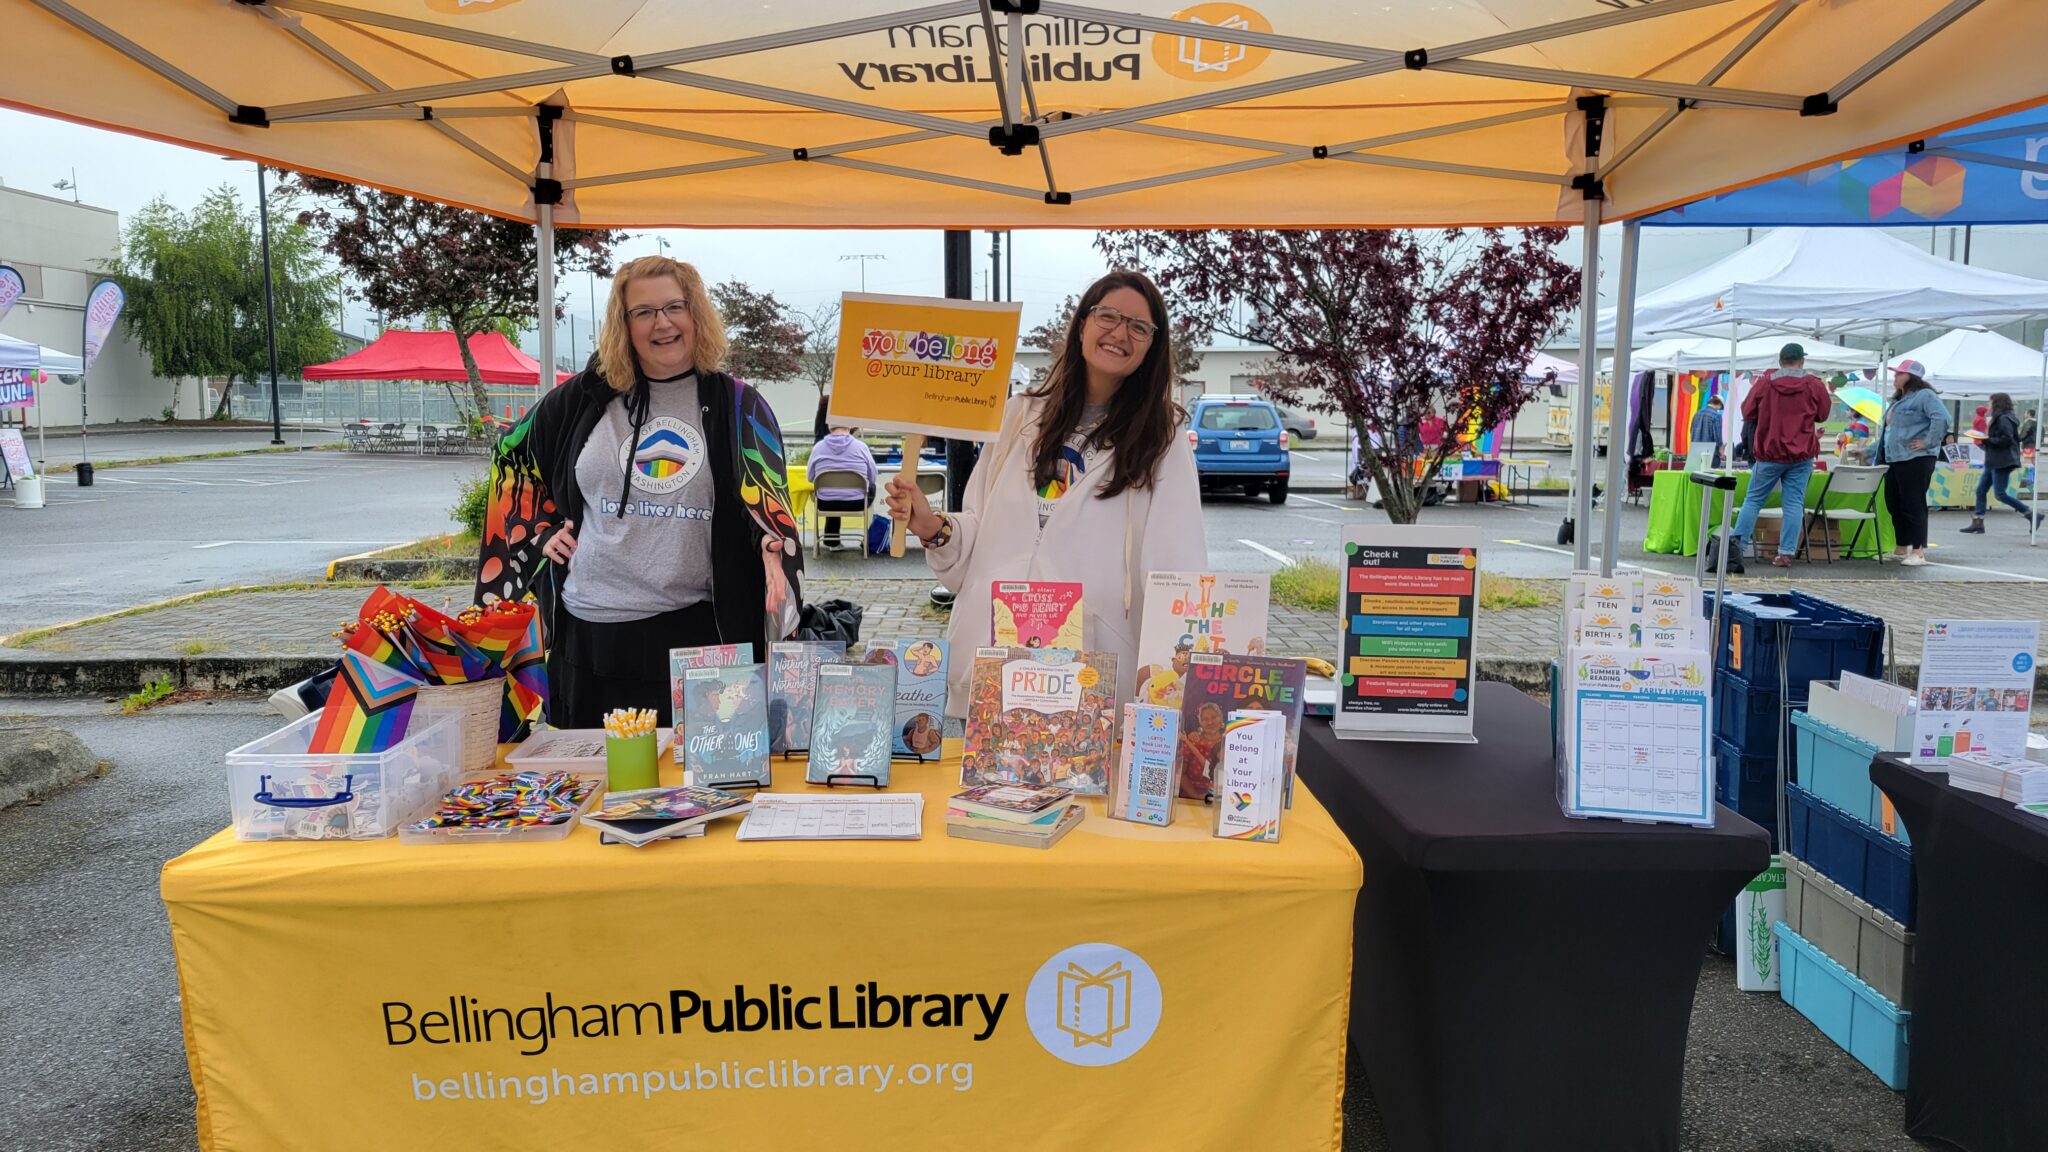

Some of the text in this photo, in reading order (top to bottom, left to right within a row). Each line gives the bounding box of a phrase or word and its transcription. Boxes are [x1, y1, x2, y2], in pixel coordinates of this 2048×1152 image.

[865, 333, 996, 367] you belong
[923, 364, 983, 387] library
[656, 419, 701, 455] BELLINGHAM
[631, 469, 691, 490] WASHINGTON
[638, 500, 673, 518] lives
[676, 502, 713, 521] here
[1363, 550, 1399, 559] Check it
[1363, 558, 1381, 566] out!
[1021, 592, 1054, 603] CROSS
[1652, 599, 1680, 607] ADULT
[1031, 602, 1067, 613] HEART
[1171, 598, 1239, 618] BATHE
[1597, 601, 1618, 609] TEEN
[1184, 619, 1223, 635] THE
[1585, 630, 1611, 639] BIRTH
[1654, 632, 1675, 640] KIDS
[1195, 663, 1284, 685] CIRCLE
[1011, 671, 1075, 695] PRIDE
[823, 684, 886, 696] MEMORY
[1206, 681, 1295, 703] OF LOVE
[1639, 687, 1705, 697] EARLY LEARNERS
[689, 730, 762, 754] OTHER ONES
[1236, 732, 1253, 741] You
[1229, 743, 1259, 755] Belong
[1238, 756, 1248, 765] at
[729, 771, 752, 779] HART
[1232, 767, 1253, 777] Your
[1227, 779, 1258, 791] Library
[381, 980, 1010, 1056] Bellingham Public Library
[411, 1056, 975, 1105] bellinghampubliclibrary.org
